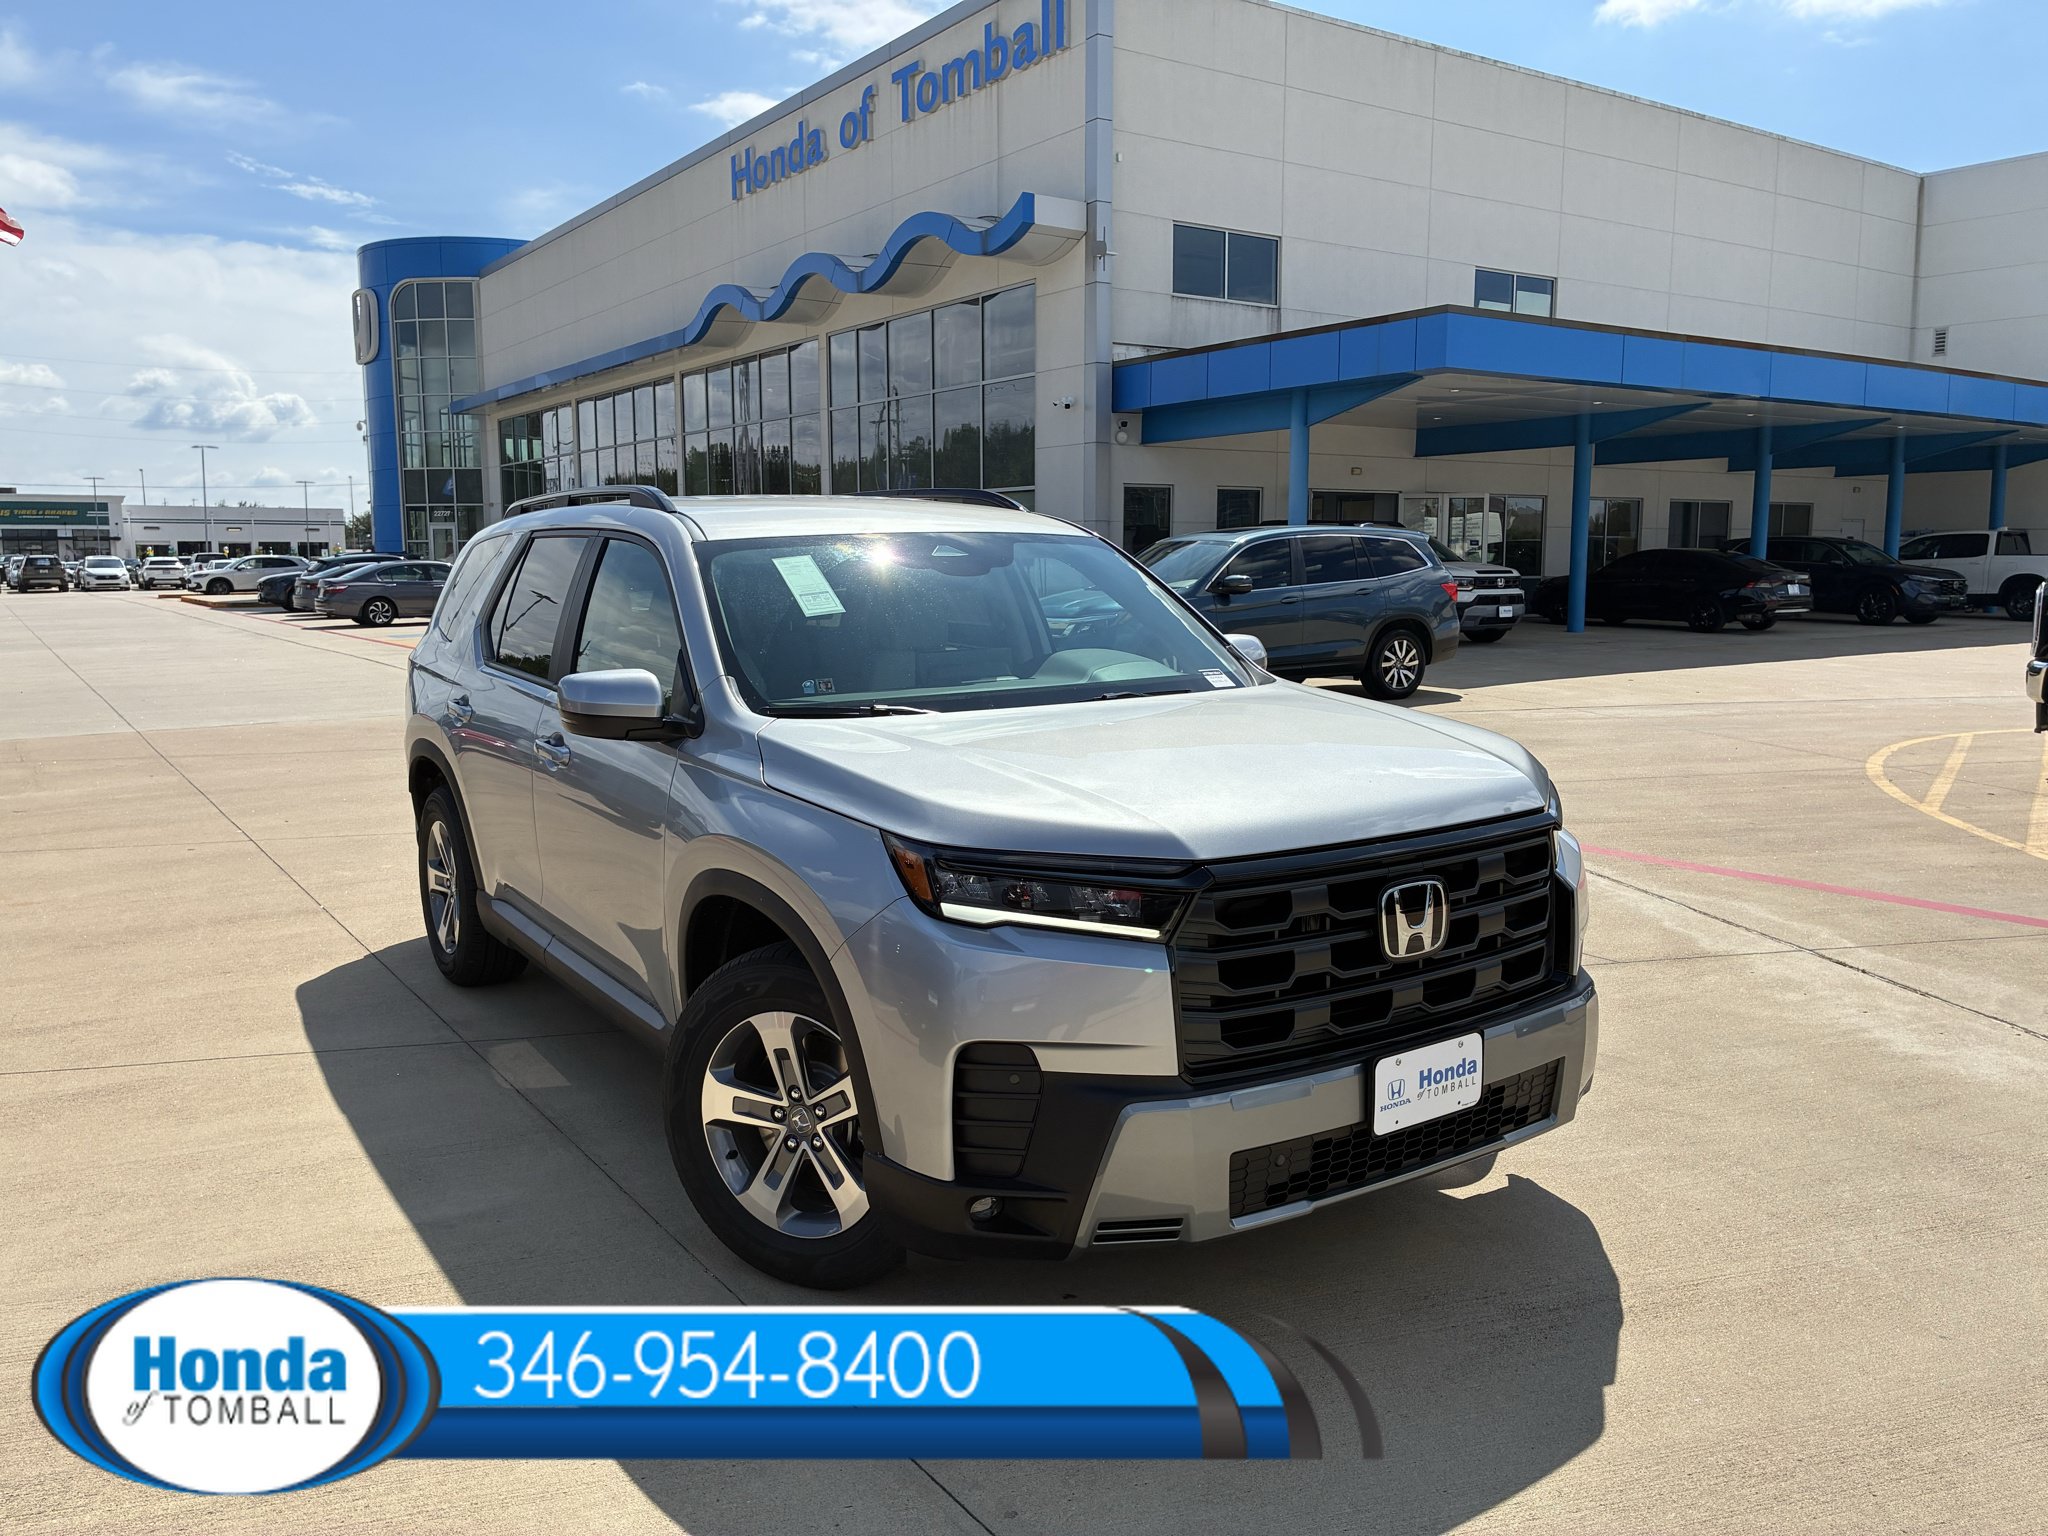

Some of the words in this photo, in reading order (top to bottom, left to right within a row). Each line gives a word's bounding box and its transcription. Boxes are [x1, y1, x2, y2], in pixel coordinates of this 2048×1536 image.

[730, 120, 827, 200] Honda
[839, 84, 877, 150] of
[891, 0, 1068, 123] Tomball
[1419, 1058, 1477, 1089] Honda
[1416, 1087, 1427, 1101] of
[1427, 1076, 1476, 1099] TOMBALL
[1379, 1098, 1412, 1112] HONDA
